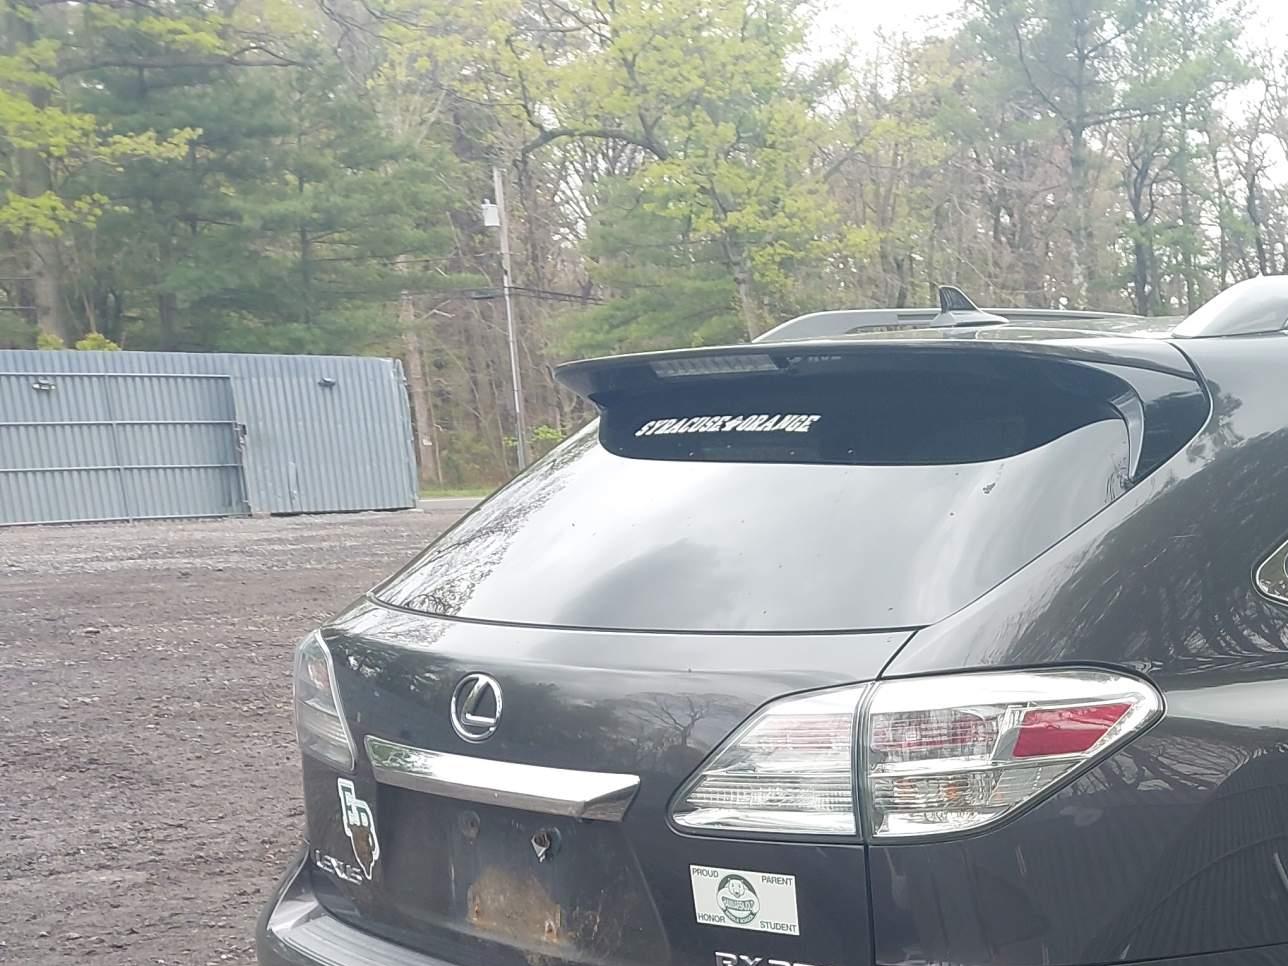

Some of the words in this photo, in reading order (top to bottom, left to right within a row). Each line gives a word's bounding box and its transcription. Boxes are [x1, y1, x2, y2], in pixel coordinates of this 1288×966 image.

[736, 414, 821, 432] ORANGE
[315, 849, 362, 885] LEXUS
[692, 868, 719, 878] PROUD
[761, 875, 794, 886] PARENT
[698, 913, 726, 923] HONOR
[760, 920, 797, 933] STUDENT
